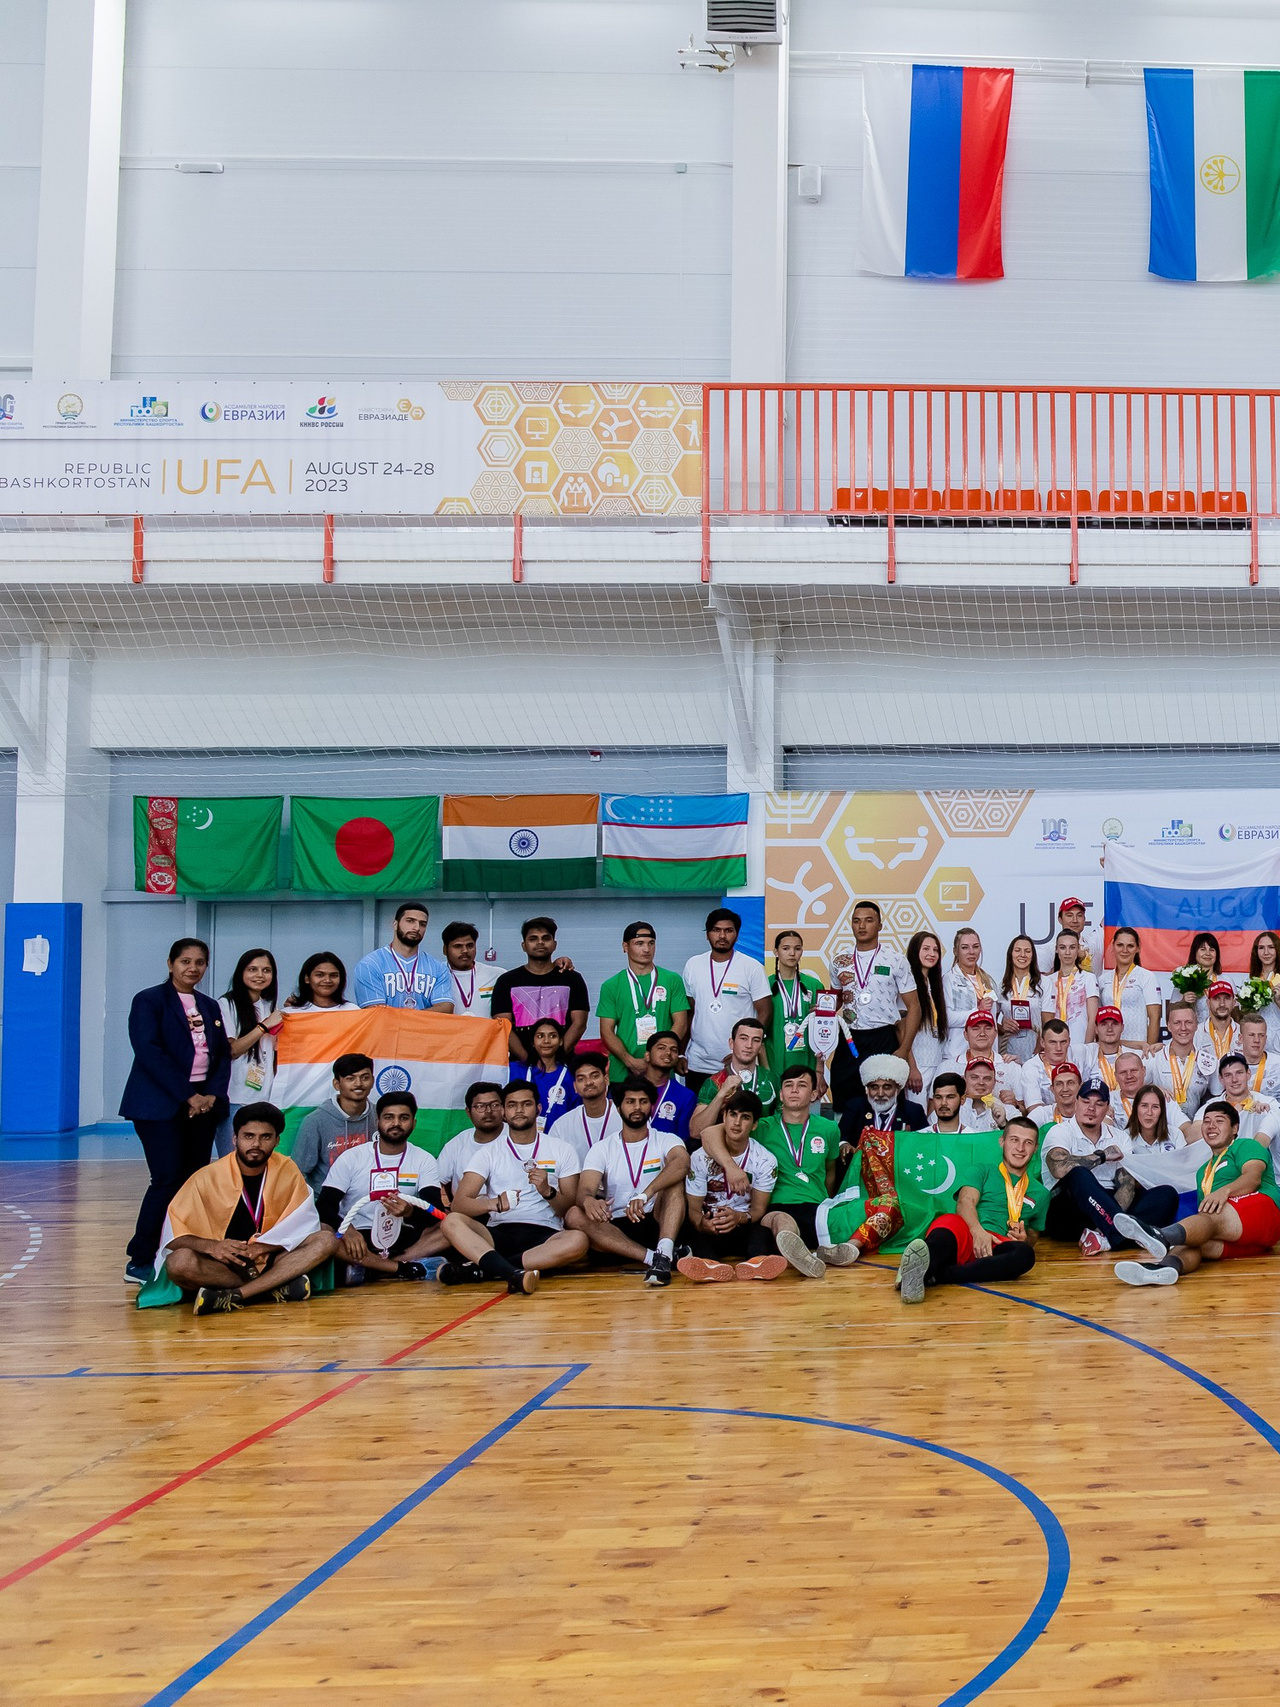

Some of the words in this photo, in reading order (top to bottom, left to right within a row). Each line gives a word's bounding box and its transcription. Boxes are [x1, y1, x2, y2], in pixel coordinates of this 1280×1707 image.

[223, 409, 286, 421] ЕВРАЗИИ
[358, 413, 409, 421] ЕВРАЗИАДЕ
[64, 463, 152, 475] REPUBLIC
[305, 462, 379, 476] AUGUST
[383, 462, 435, 476] 24-28
[0, 477, 151, 489] BASHKORTOSTAN
[176, 459, 277, 495] UFA
[305, 479, 349, 492] 2023
[384, 972, 437, 999] ROUGH
[1088, 1195, 1113, 1225] RUSSIA
